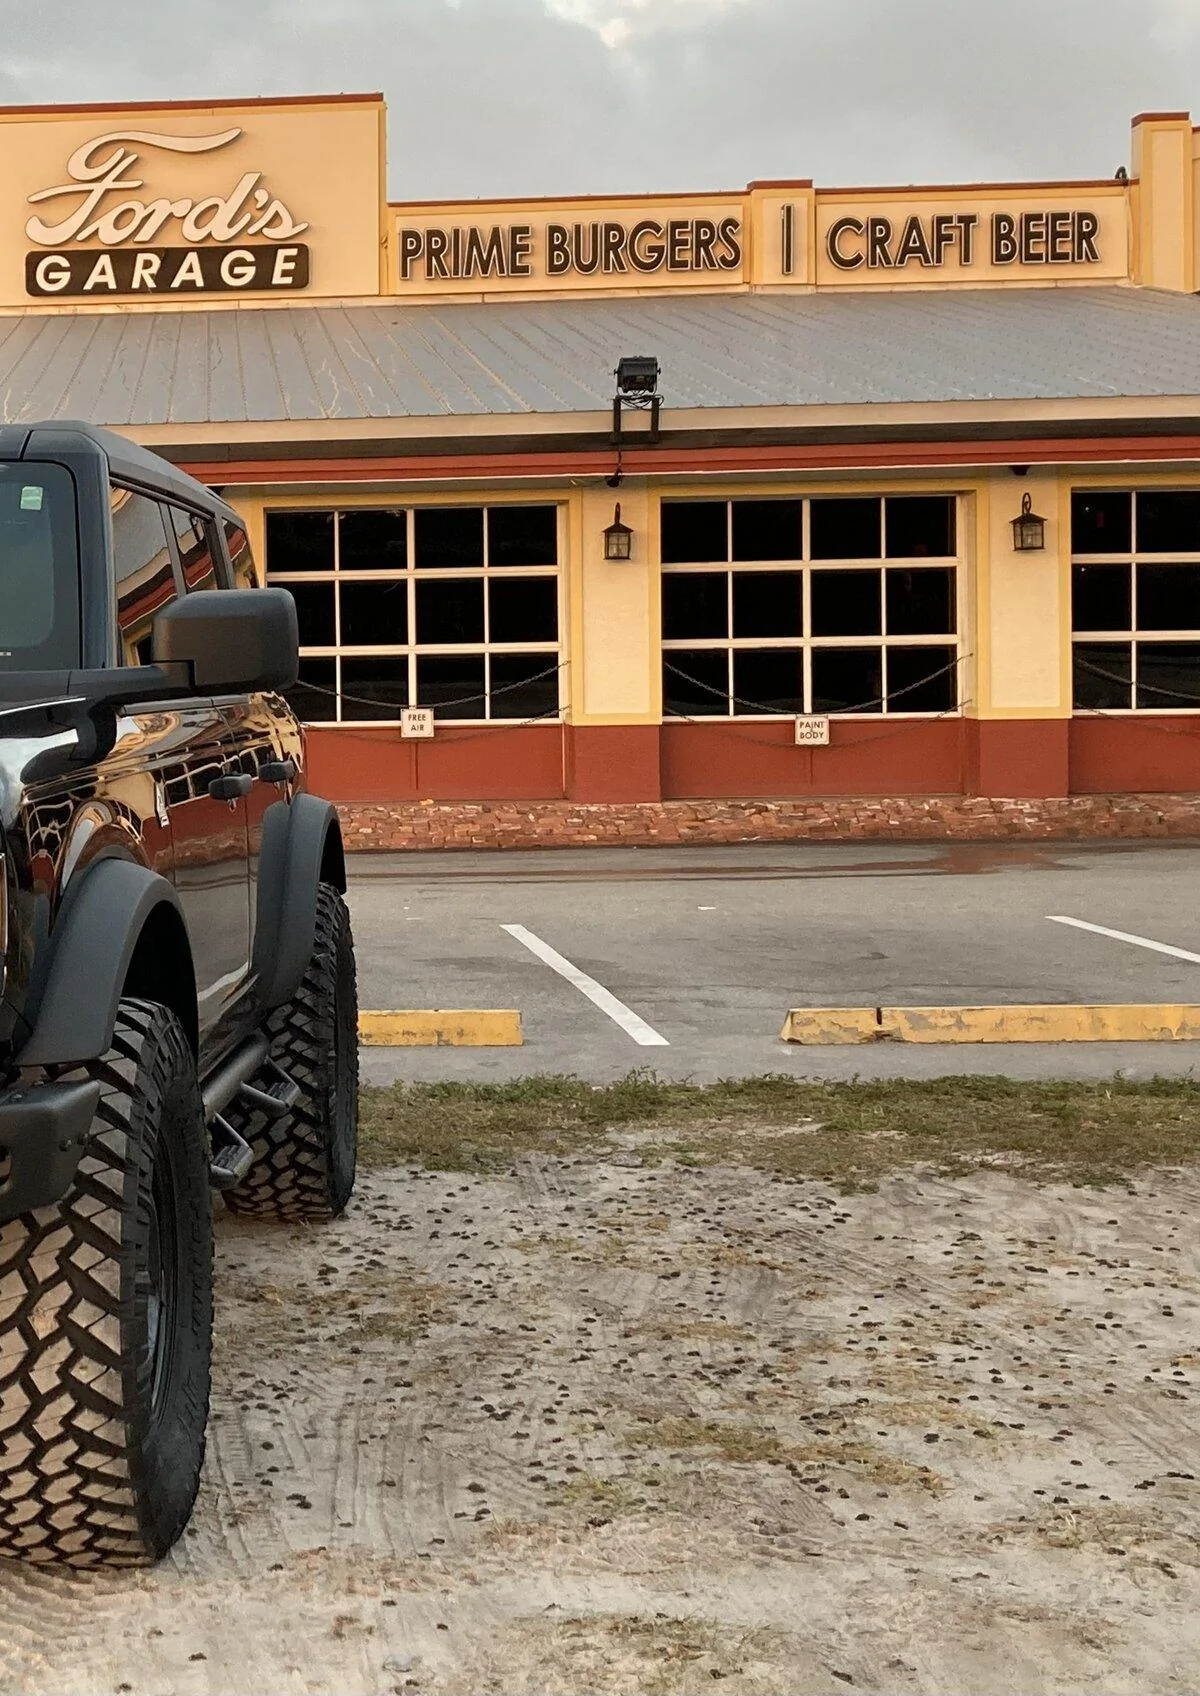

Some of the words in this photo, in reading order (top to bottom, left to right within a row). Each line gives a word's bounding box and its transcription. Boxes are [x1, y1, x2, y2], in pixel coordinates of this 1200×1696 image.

[25, 127, 310, 246] Ford's
[400, 225, 533, 280] PRIME
[546, 217, 742, 275] BURGERS
[826, 212, 978, 269] CRAFT
[991, 210, 1100, 266] BEER
[36, 247, 299, 292] GARAGE
[408, 713, 427, 721] FREE
[800, 731, 825, 739] BODY
